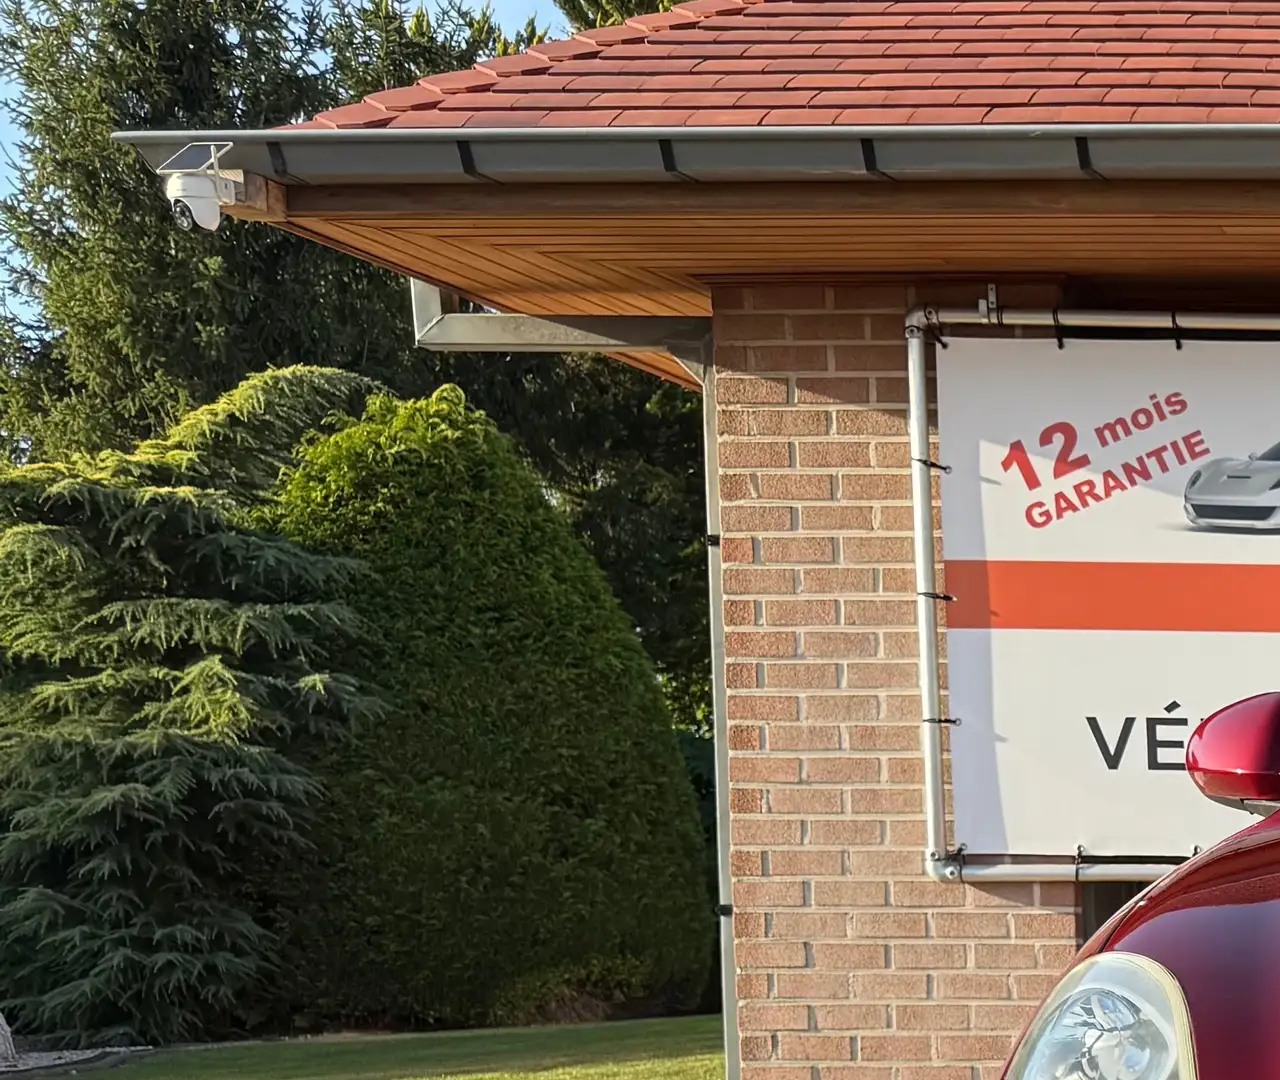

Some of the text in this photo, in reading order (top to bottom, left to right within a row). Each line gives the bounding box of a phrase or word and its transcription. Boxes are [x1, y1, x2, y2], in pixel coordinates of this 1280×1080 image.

[1001, 392, 1188, 491] 12 mois
[1025, 430, 1211, 528] GARANTIE
